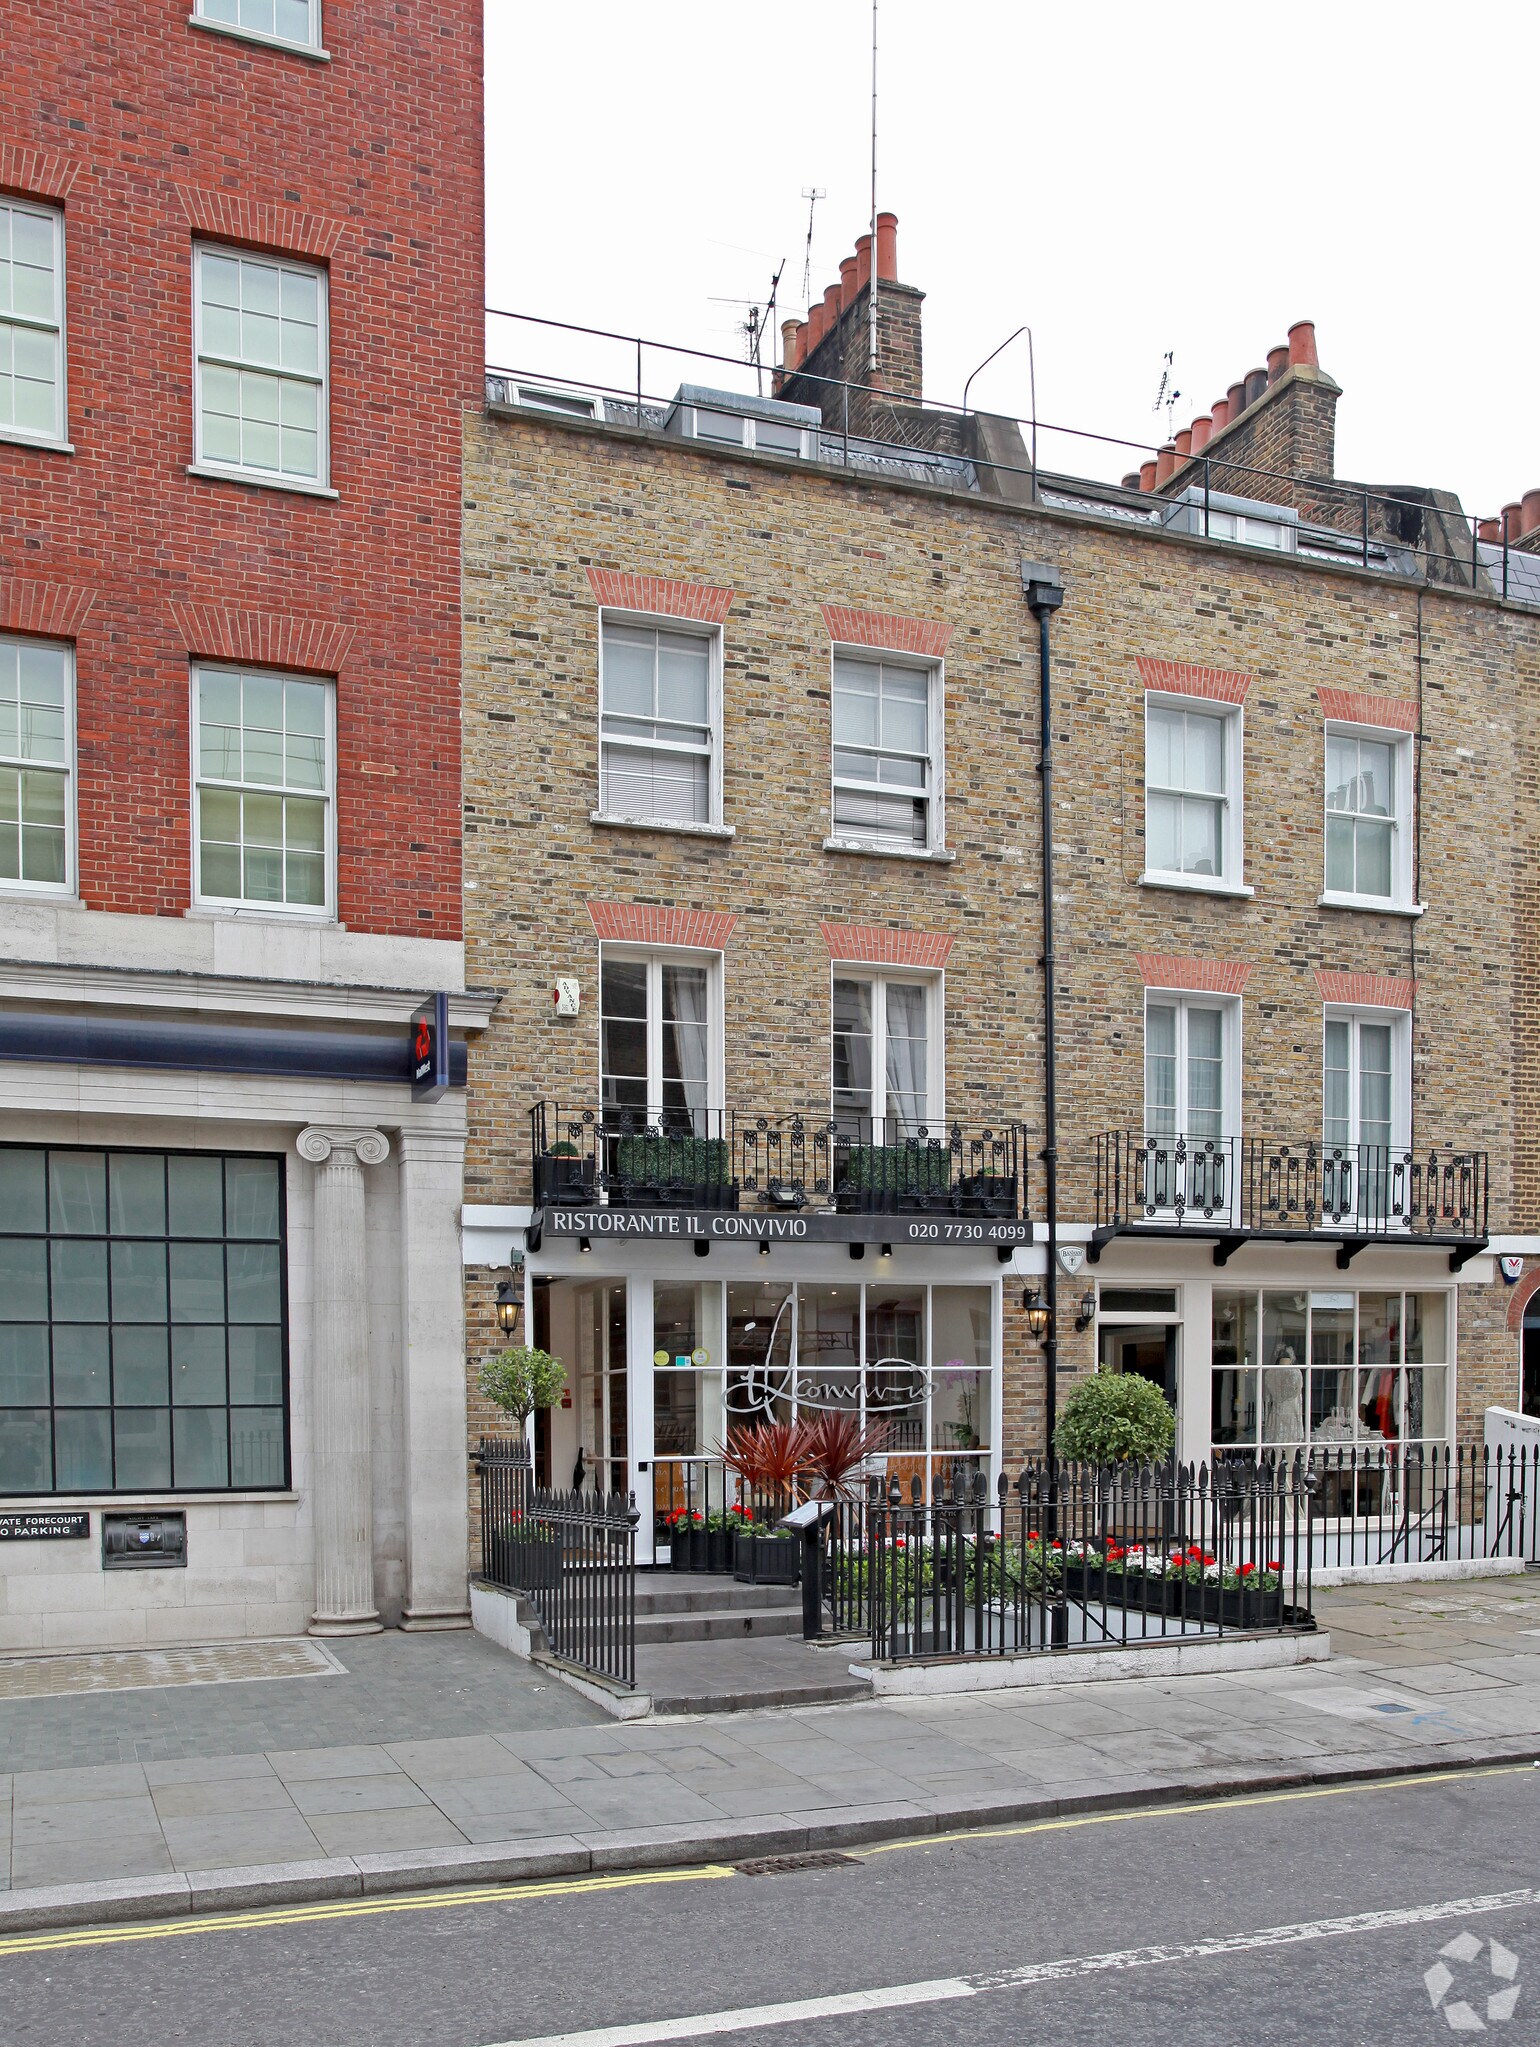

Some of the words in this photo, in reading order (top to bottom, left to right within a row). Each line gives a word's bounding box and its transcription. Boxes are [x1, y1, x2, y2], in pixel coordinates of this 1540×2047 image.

[562, 981, 578, 1012] ADVANCE
[553, 1212, 680, 1233] RISTORANTE
[685, 1216, 705, 1234] IL
[712, 1217, 807, 1236] CONVIVIO
[909, 1224, 939, 1238] 020
[944, 1225, 983, 1239] 7730
[988, 1226, 1026, 1240] 4099
[26, 1516, 84, 1525] FORECOURT
[14, 1526, 70, 1536] PARKING
